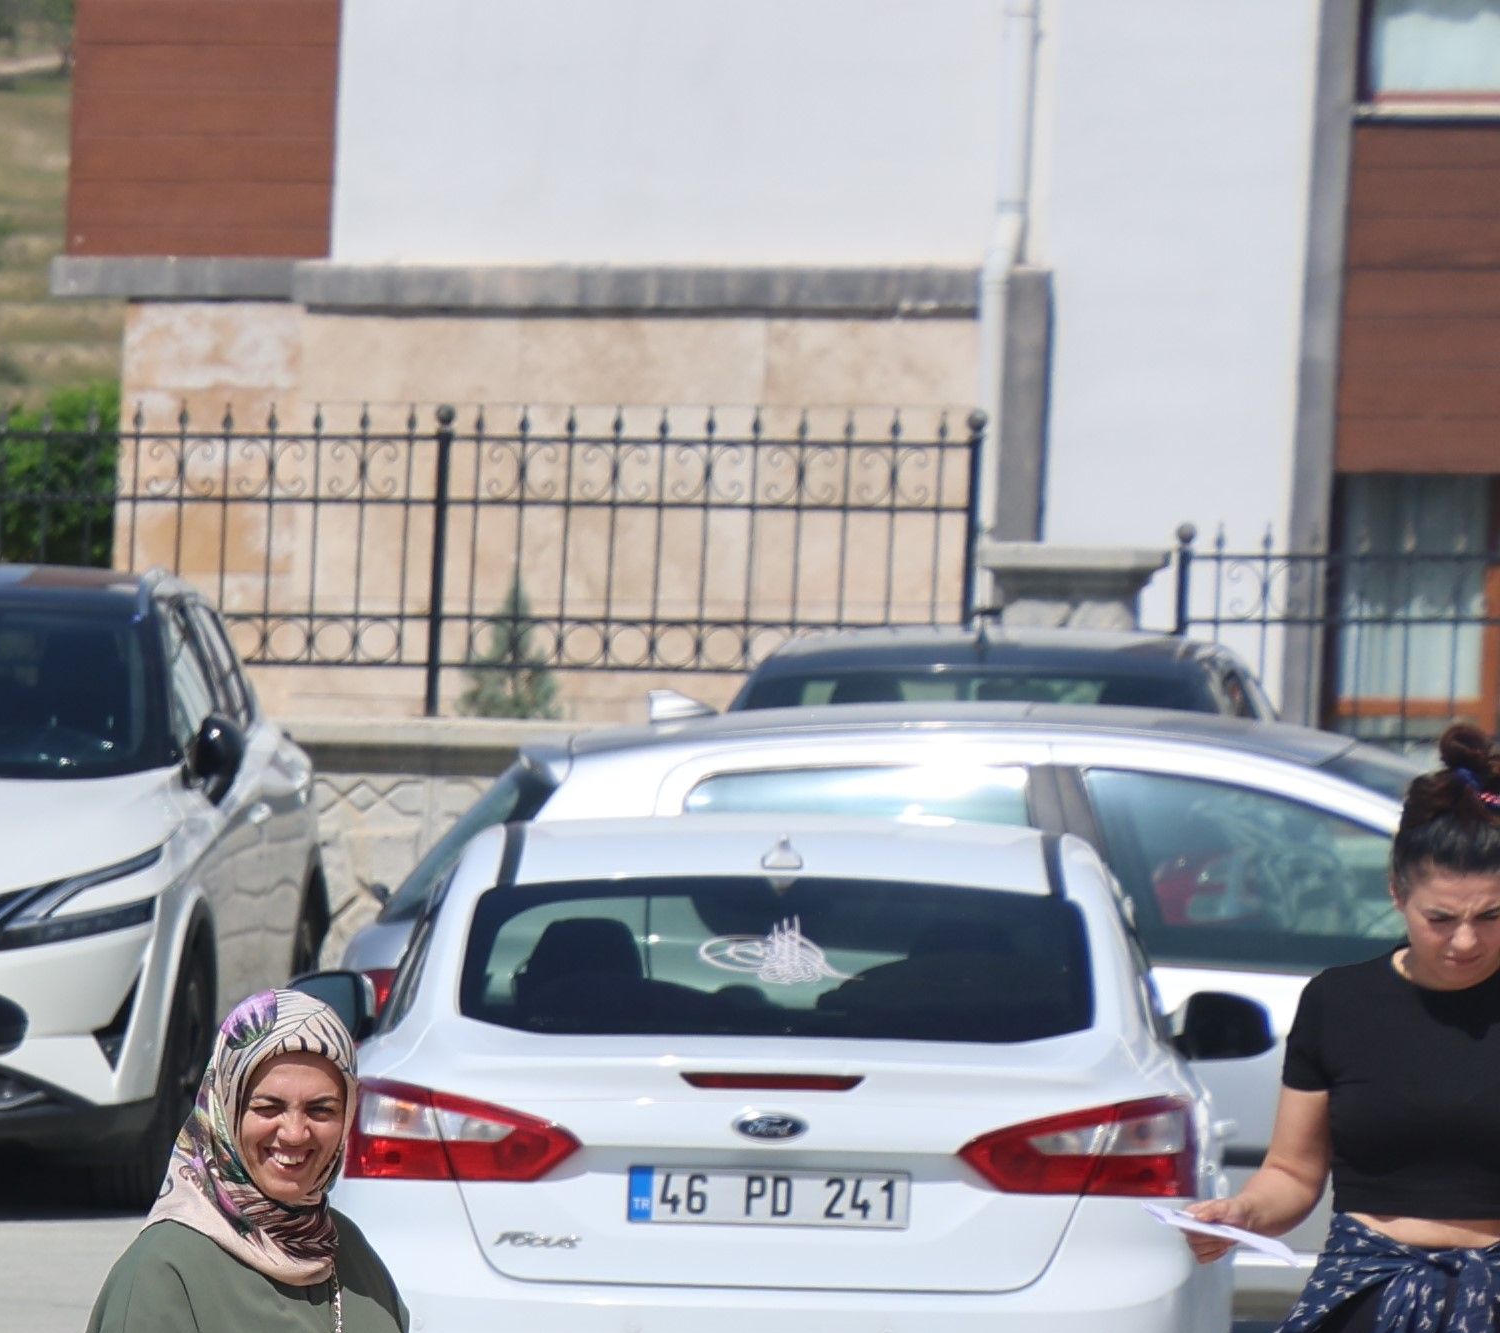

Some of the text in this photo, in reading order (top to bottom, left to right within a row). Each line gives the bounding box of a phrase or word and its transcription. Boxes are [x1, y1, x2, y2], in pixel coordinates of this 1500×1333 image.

[633, 1173, 897, 1220] TR 46 PD 241
